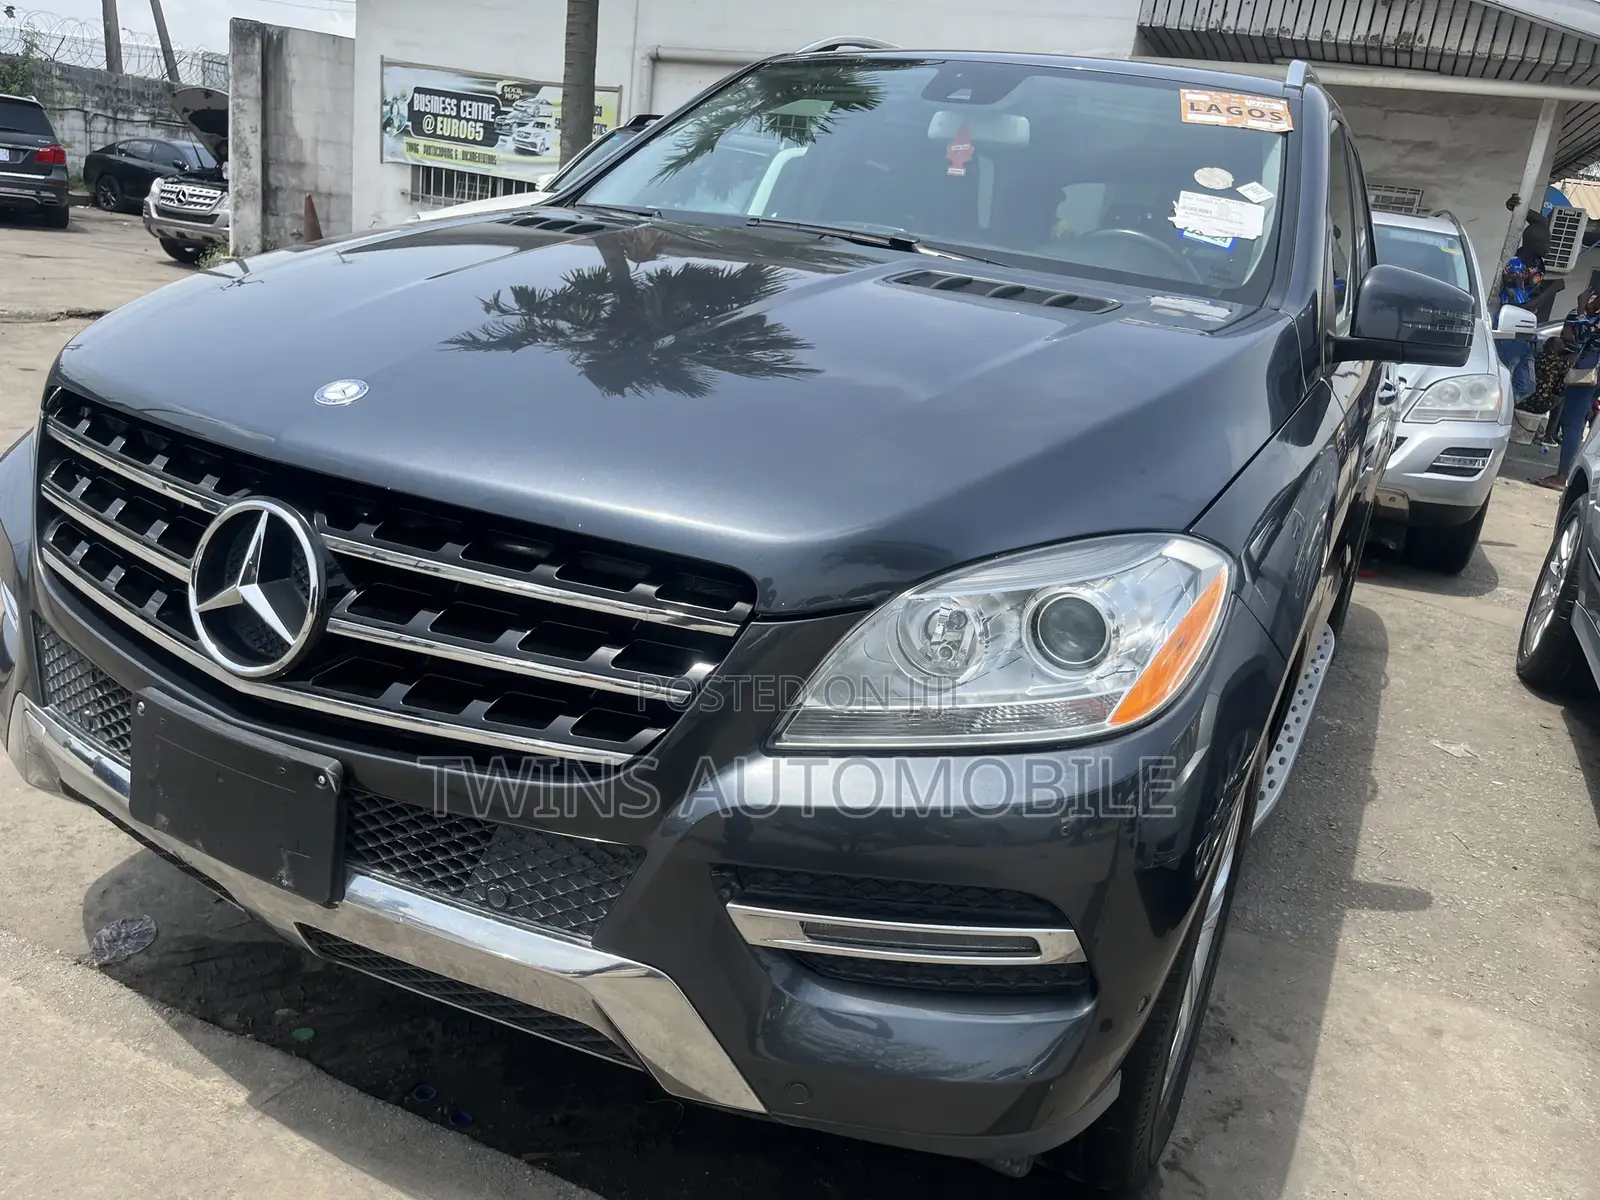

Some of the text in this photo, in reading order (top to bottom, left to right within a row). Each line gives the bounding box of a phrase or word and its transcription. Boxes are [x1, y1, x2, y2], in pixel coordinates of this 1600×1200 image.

[413, 93, 496, 122] BUSINESS CENTRE
[1189, 101, 1283, 122] LAGOS
